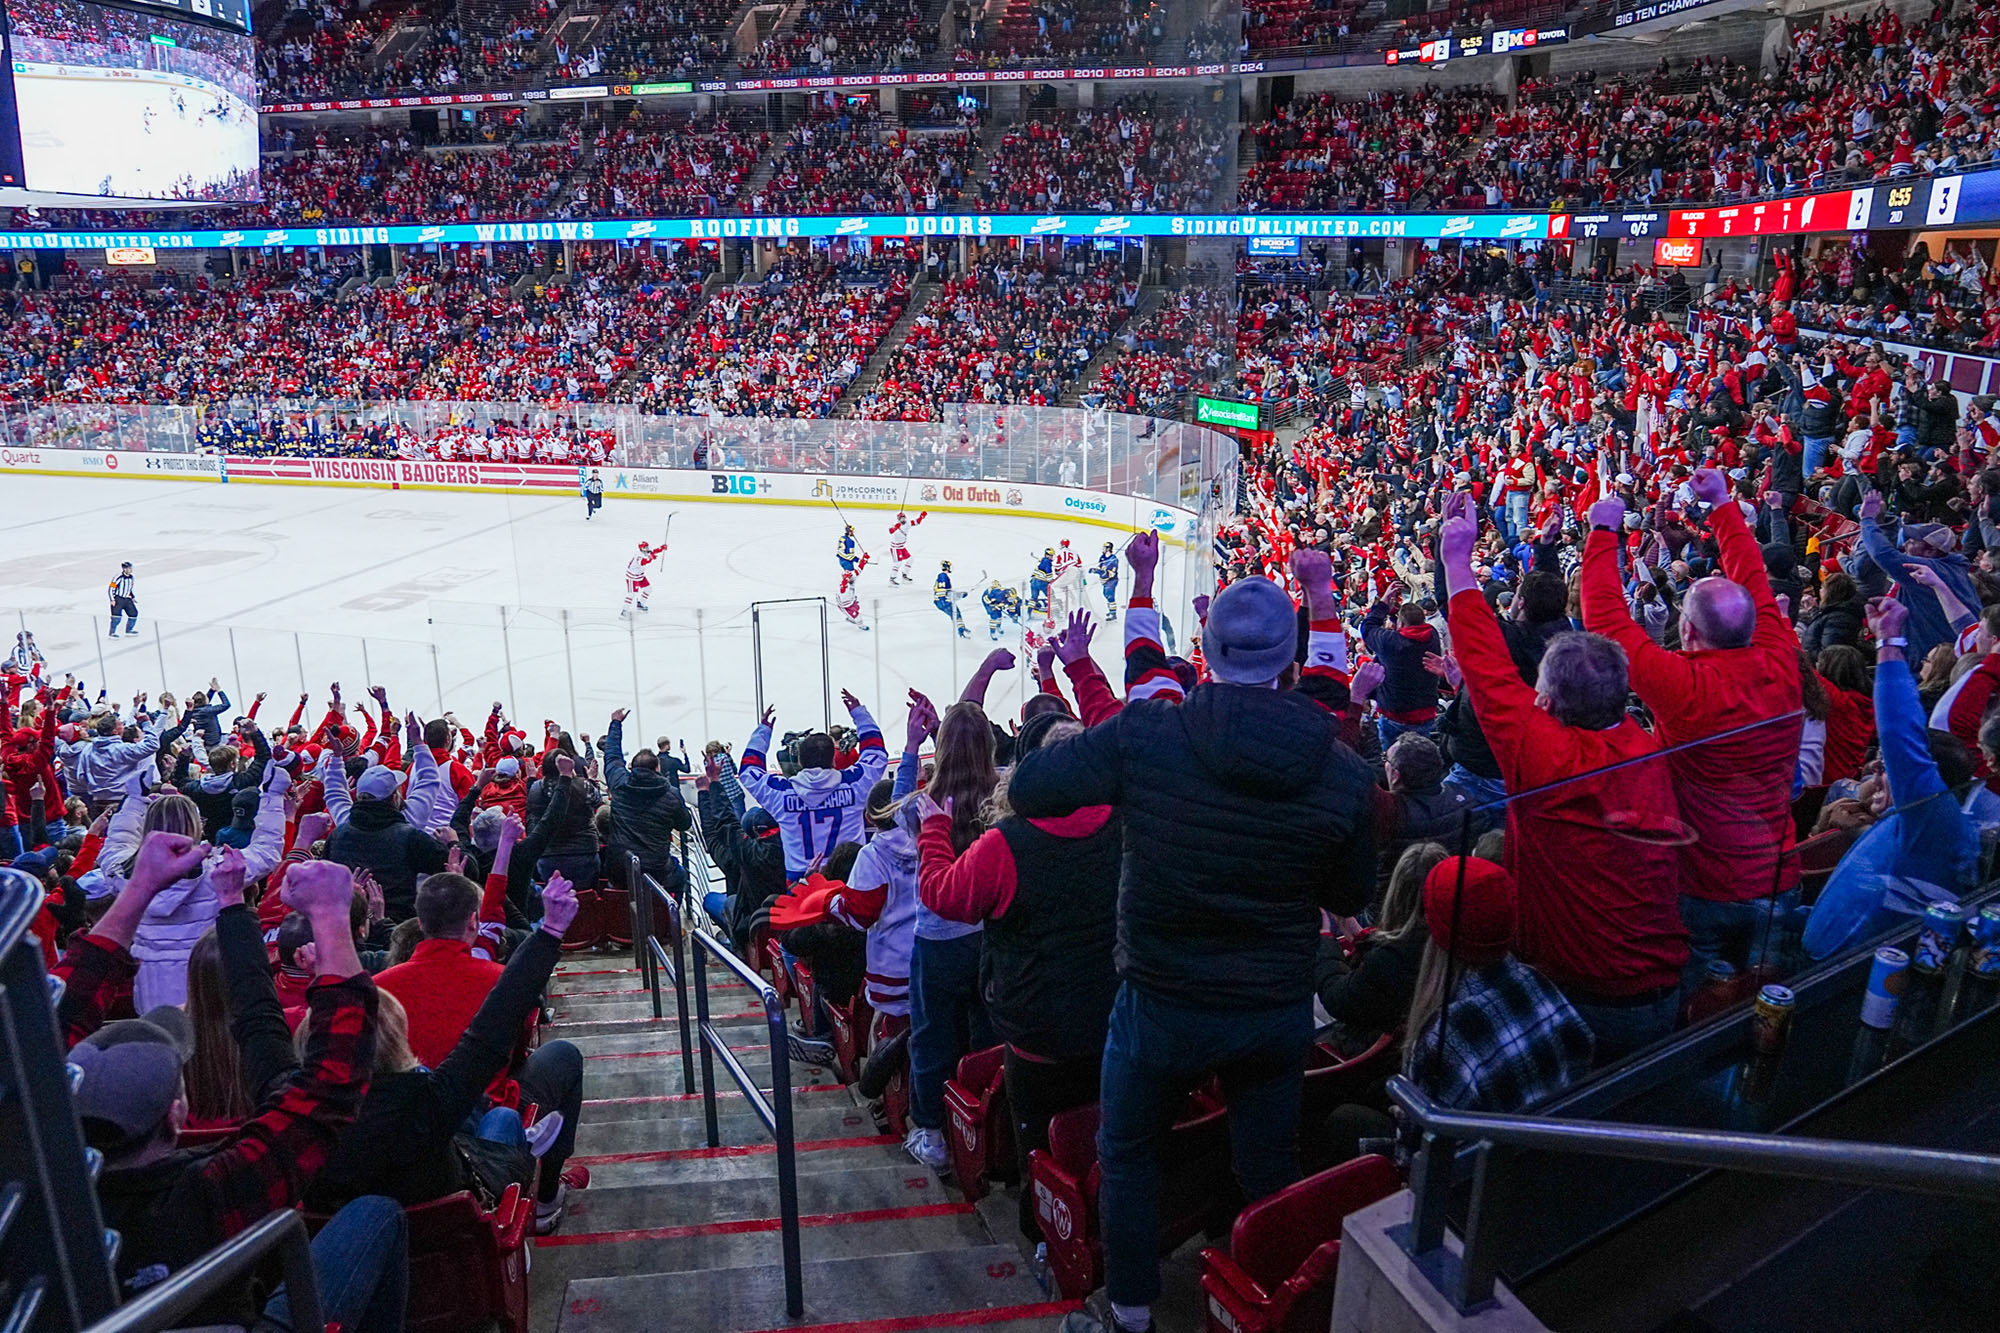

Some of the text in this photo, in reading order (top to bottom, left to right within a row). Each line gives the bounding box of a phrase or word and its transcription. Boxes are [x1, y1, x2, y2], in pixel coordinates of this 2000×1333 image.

[1616, 14, 1632, 26] BIG
[1636, 8, 1657, 20] TEN
[1537, 29, 1566, 40] TOYOTA
[1460, 36, 1482, 48] 8:55
[1498, 37, 1504, 47] 3
[1439, 45, 1445, 55] 2
[1114, 68, 1145, 77] 2013
[1155, 67, 1186, 76] 2014
[1197, 65, 1225, 74] 2021
[1231, 63, 1264, 73] 2024
[880, 74, 908, 83] 2001
[916, 73, 947, 82] 2004
[955, 72, 986, 81] 2005
[994, 71, 1025, 80] 2006
[1033, 70, 1065, 79] 2008
[1073, 69, 1104, 78] 2010
[735, 81, 761, 89] 1994
[771, 79, 797, 88] 1995
[807, 77, 834, 86] 1998
[842, 76, 872, 84] 2000
[614, 85, 632, 95] 8:42
[700, 82, 726, 91] 1993
[428, 96, 452, 104] 1989
[459, 94, 482, 102] 1990
[491, 92, 513, 100] 1991
[522, 91, 546, 99] 1992
[309, 102, 332, 110] 1981
[338, 101, 361, 109] 1982
[368, 99, 391, 107] 1983
[398, 97, 421, 105] 1988
[1888, 186, 1912, 207] 8:55
[1939, 187, 1951, 216] 3
[1855, 197, 1864, 220] 2
[1681, 212, 1705, 220] BLOCKS
[690, 218, 800, 236] ROOFING
[905, 216, 992, 235] DOORS
[1584, 223, 1598, 237] 1/2
[1630, 221, 1649, 237] 0/3
[1688, 222, 1697, 235] 3
[475, 222, 595, 240] WINDOWS
[317, 228, 389, 245] SIDING
[1260, 239, 1295, 247] NICHOLAS
[1661, 242, 1695, 260] Quartz
[1, 448, 40, 466] Quartz
[82, 456, 103, 466] BMO
[163, 458, 185, 471] PROTECT
[186, 458, 198, 471] THIS
[312, 460, 480, 484] WISCONSIN BADGERS
[632, 473, 659, 484] Alliant
[836, 493, 897, 501] PROPERTIES
[942, 485, 1001, 503] Old Dutch
[1064, 497, 1107, 513] Odyssey
[798, 806, 843, 861] 17
[904, 1177, 929, 1190] R
[986, 1261, 1017, 1280] S
[1216, 1303, 1226, 1319] T
